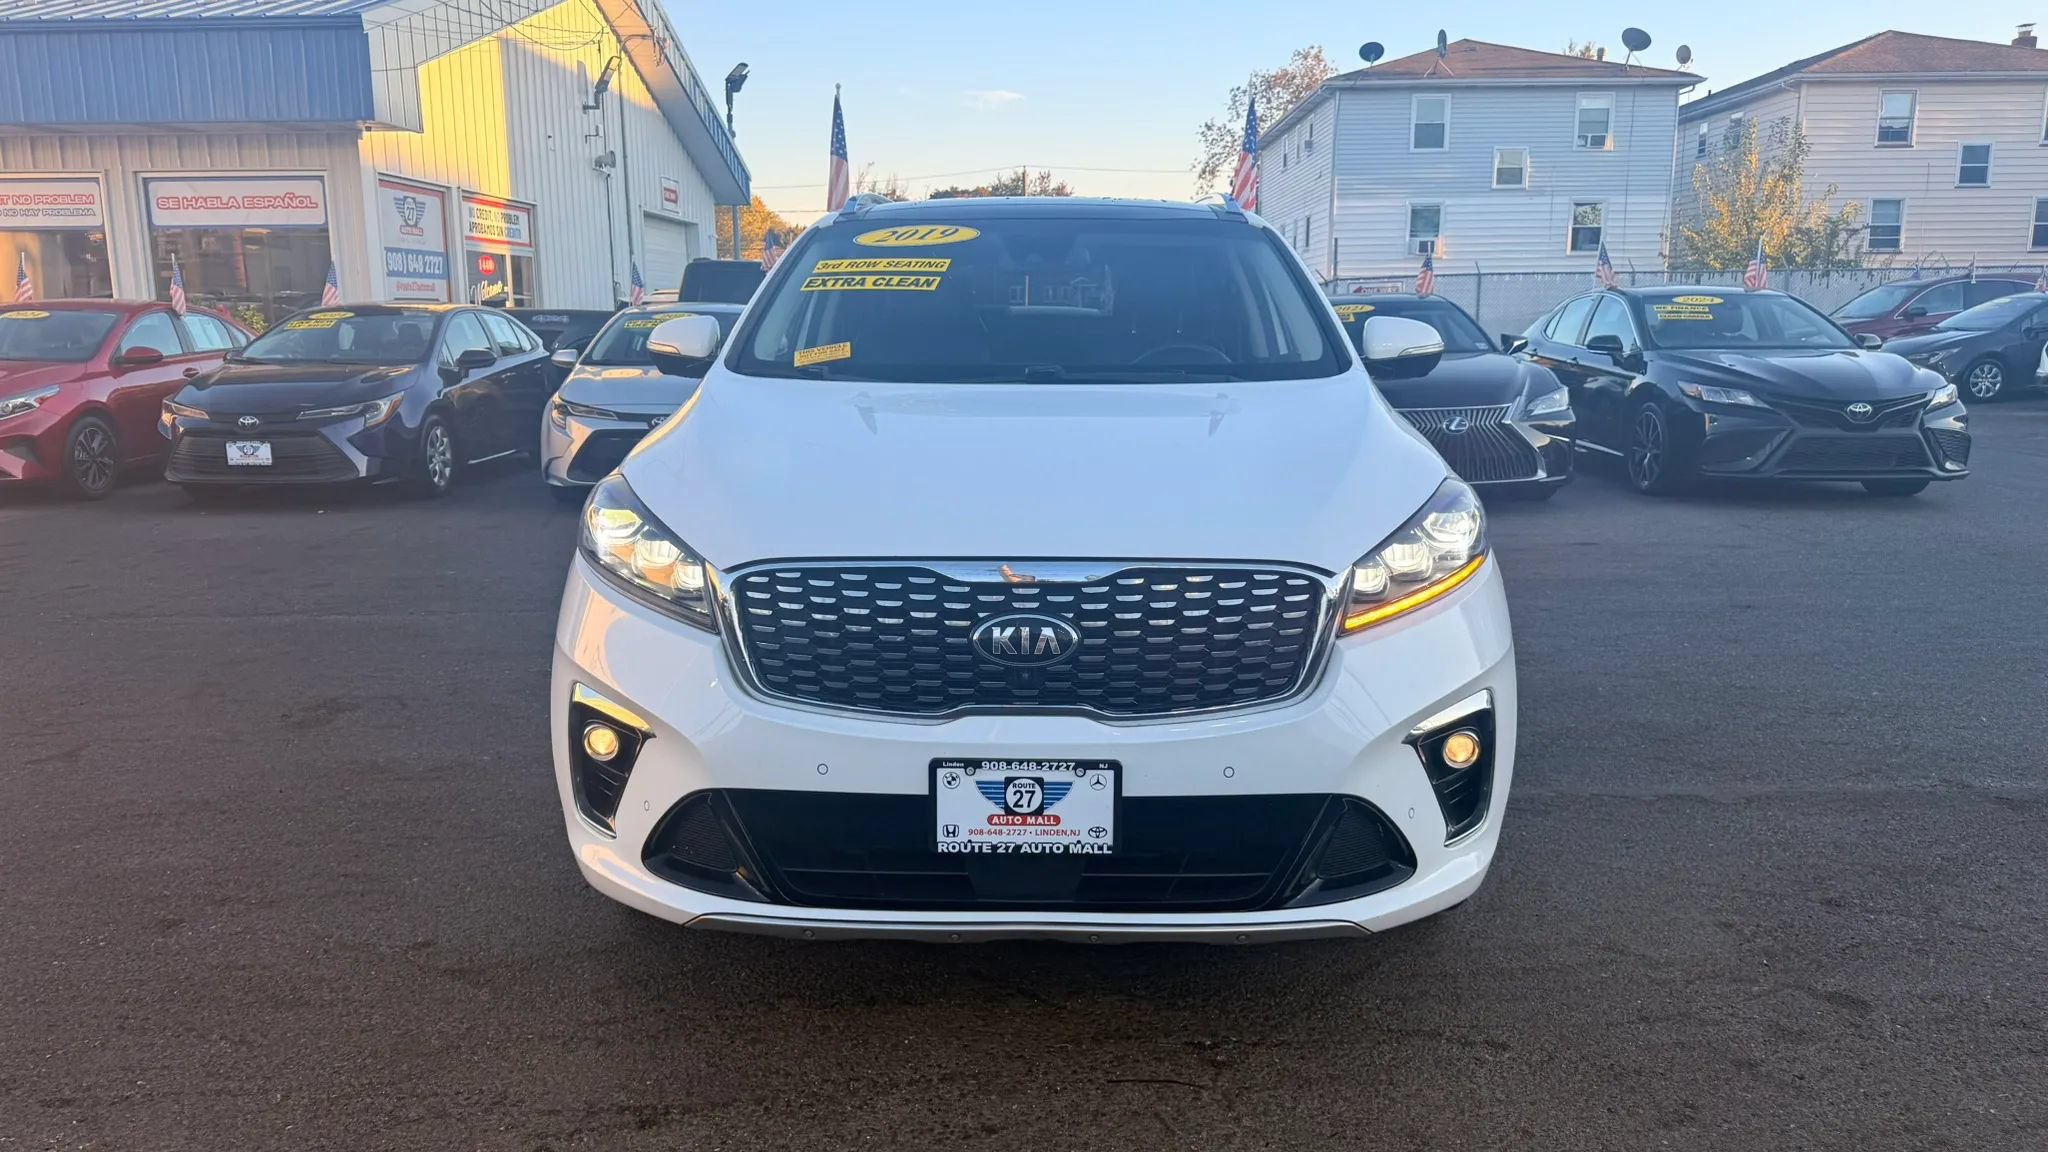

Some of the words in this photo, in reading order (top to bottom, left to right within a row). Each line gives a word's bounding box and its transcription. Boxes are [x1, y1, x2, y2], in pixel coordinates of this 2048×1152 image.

[12, 194, 32, 205] NO
[33, 194, 95, 205] PROBLEM
[157, 196, 180, 209] SE
[182, 196, 240, 209] HABLA
[243, 192, 318, 209] ESPAÑOL
[3, 208, 18, 216] NO
[20, 208, 40, 216] HAY
[42, 207, 96, 216] PROBLEMA
[406, 206, 415, 220] 27
[873, 227, 960, 243] 2019
[384, 251, 407, 274] (908)
[408, 253, 424, 273] 648
[424, 255, 443, 274] 2727
[817, 261, 843, 271] 3rd
[846, 260, 881, 269] ROW
[883, 260, 946, 269] SEATING
[804, 277, 867, 288] EXTRA
[871, 277, 937, 288] CLEAN
[991, 627, 1061, 655] KIA
[982, 761, 1076, 771] 908-648-2727
[1012, 790, 1036, 808] 27
[992, 816, 1022, 825] AUTO
[1027, 816, 1057, 825] MALL
[968, 828, 1027, 836] 908-648-2727
[1034, 828, 1081, 837] LINDEN,NJ
[937, 842, 992, 854] ROUTE
[996, 842, 1016, 854] 27
[1020, 842, 1064, 854] AUTO
[1069, 842, 1113, 855] MALL
